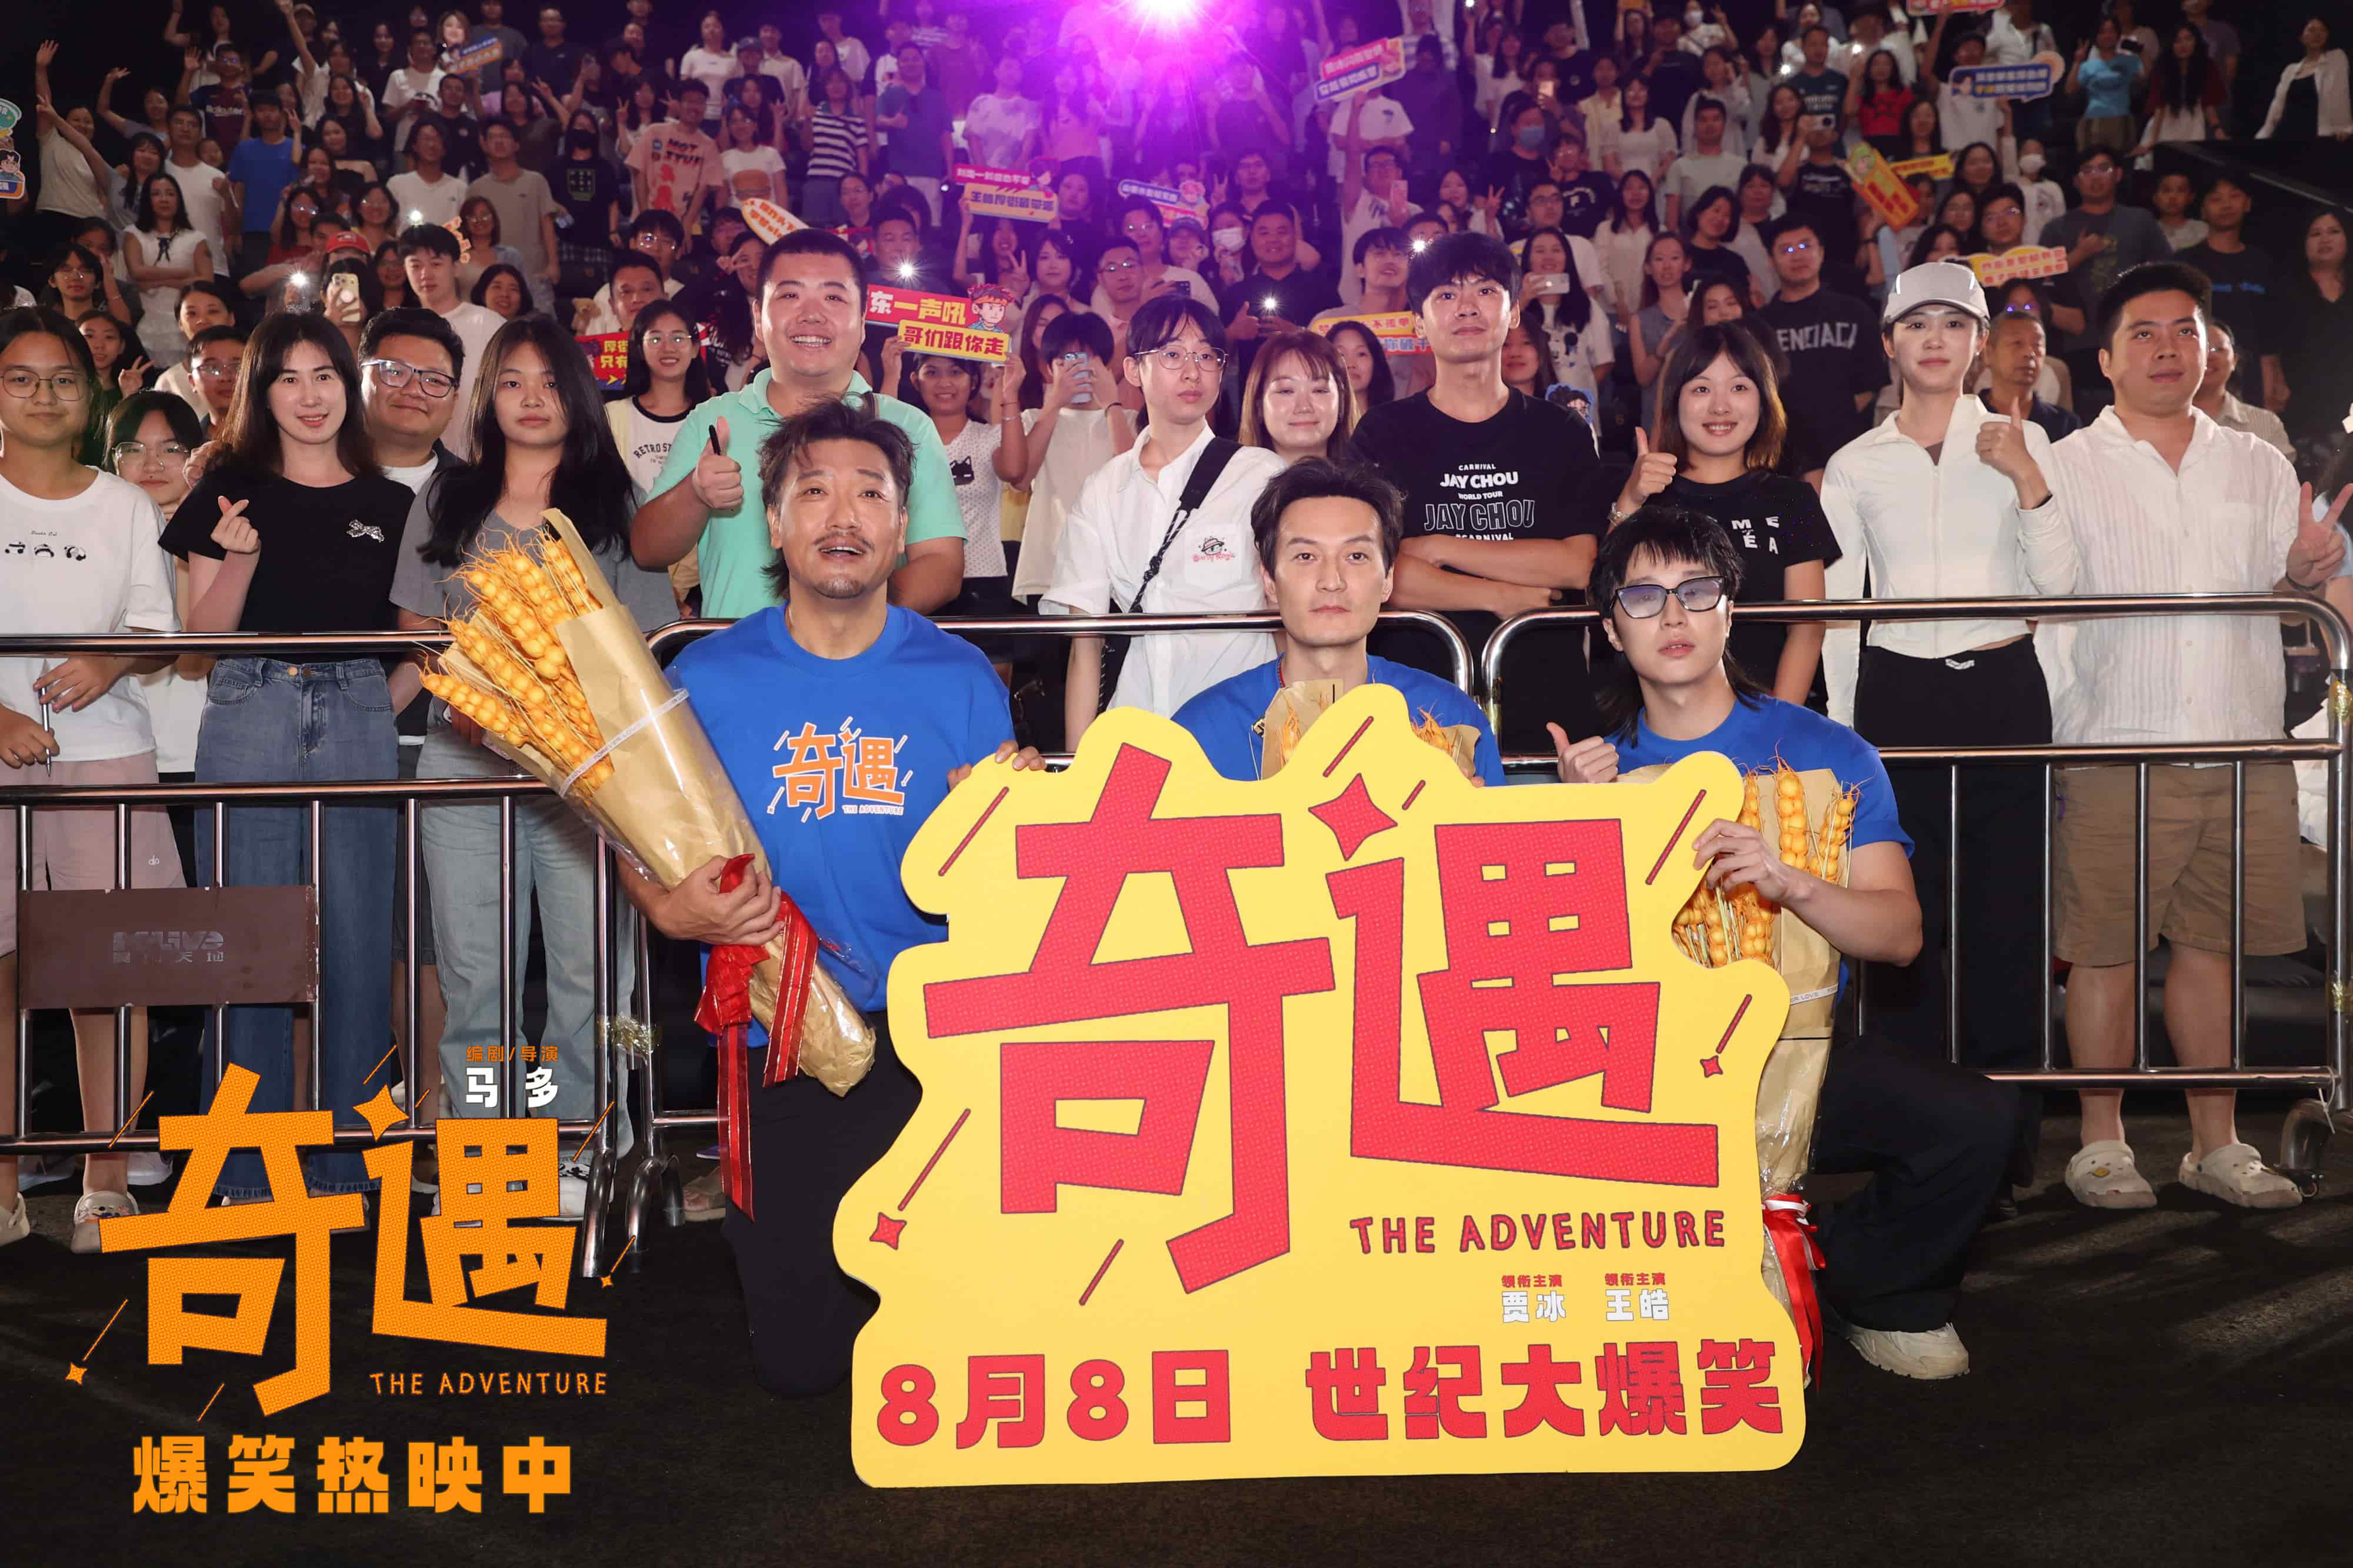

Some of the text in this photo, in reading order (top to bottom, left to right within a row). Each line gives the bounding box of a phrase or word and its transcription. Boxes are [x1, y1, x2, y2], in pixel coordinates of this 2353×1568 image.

[870, 291, 966, 325] 东一声吼
[903, 325, 1005, 355] 哥们跟你走
[600, 355, 628, 369] 只有
[634, 443, 661, 458] RETRO
[1440, 471, 1518, 489] JAY CHOU
[1482, 491, 1503, 499] TOUR
[1424, 499, 1535, 531] JAY CHOU
[772, 722, 905, 820] 奇遇
[842, 805, 904, 816] THE ADVENTURE
[923, 742, 1719, 1294] 奇遇
[1351, 1210, 1726, 1255] THE ADVENTURE
[1501, 1275, 1563, 1288] 领衔主演
[1604, 1272, 1666, 1286] 领衔主演
[1501, 1290, 1566, 1323] 贾冰
[1605, 1288, 1669, 1322] 王皓
[878, 1338, 1784, 1449] 8月8日 世纪大爆笑
